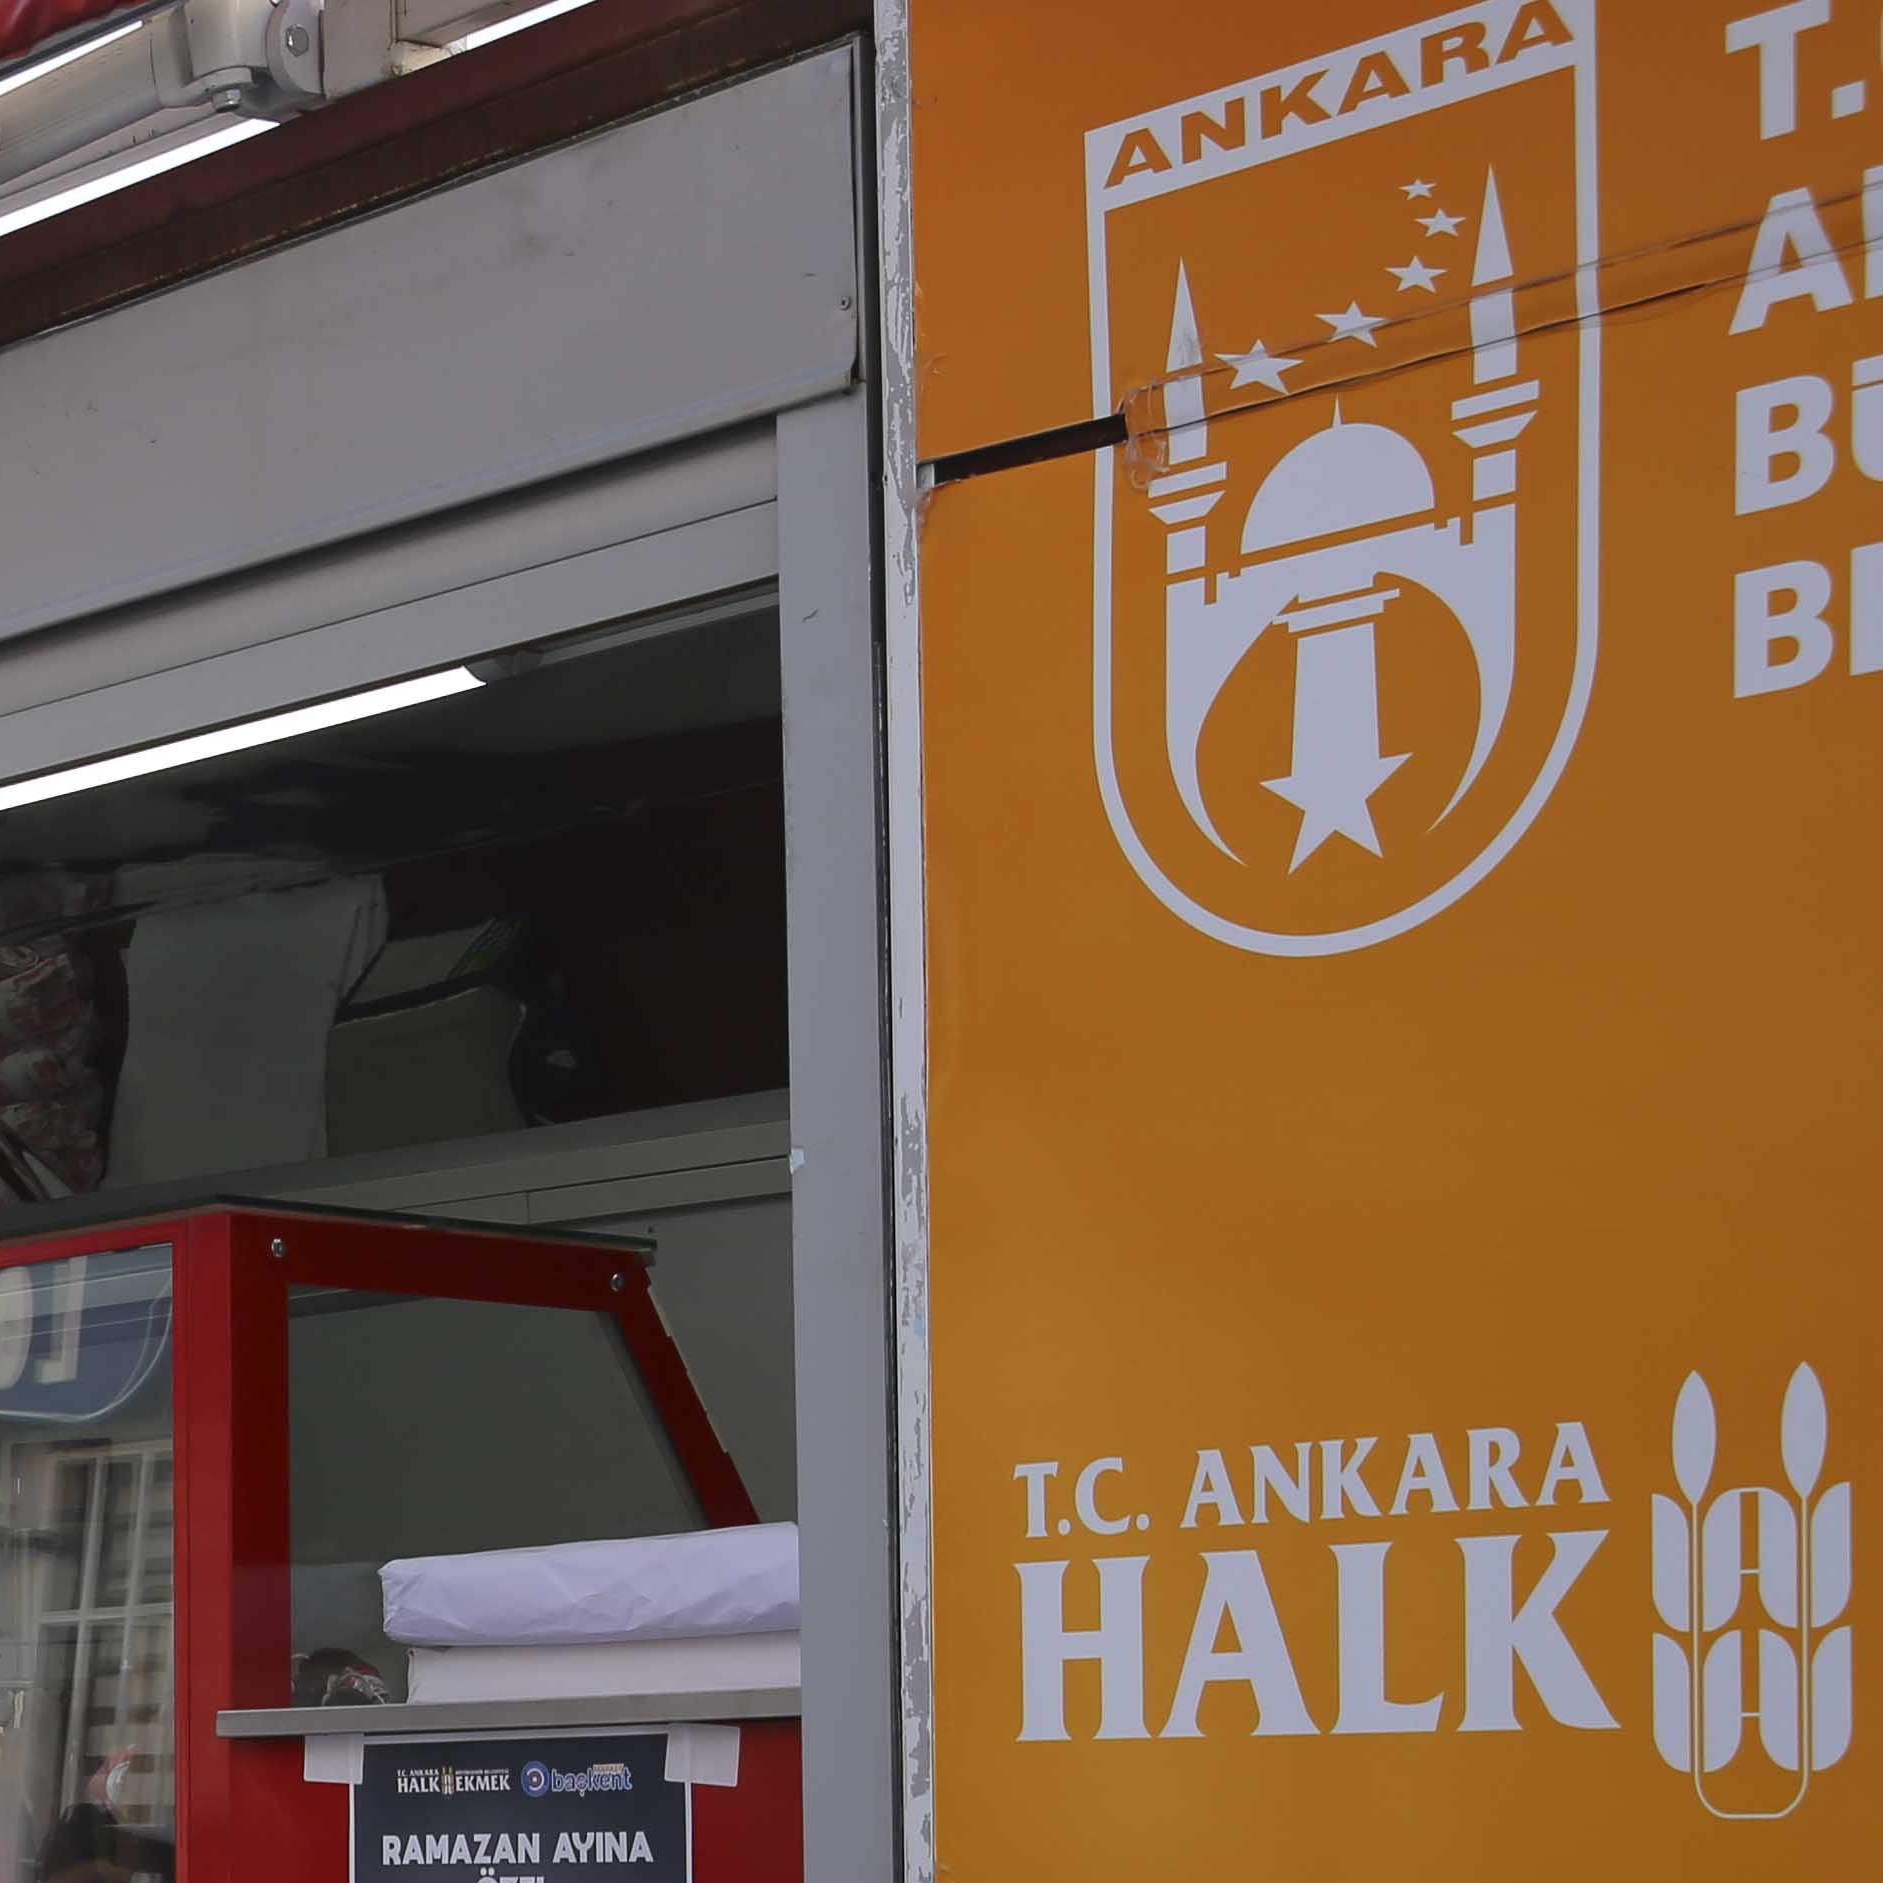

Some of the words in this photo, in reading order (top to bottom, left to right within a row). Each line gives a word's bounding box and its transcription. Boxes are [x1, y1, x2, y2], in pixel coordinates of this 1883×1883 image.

[1102, 0, 1576, 190] ANKARA
[1725, 0, 1883, 141] T.
[1012, 1455, 1151, 1540] T.C.
[1180, 1420, 1612, 1530] ANKARA
[1012, 1528, 1622, 1743] HALK
[397, 1776, 441, 1793] HALK
[455, 1775, 511, 1792] EKMEK
[551, 1766, 634, 1798] başkent
[381, 1832, 541, 1866] RAMAZAN
[552, 1831, 654, 1864] AYINA
